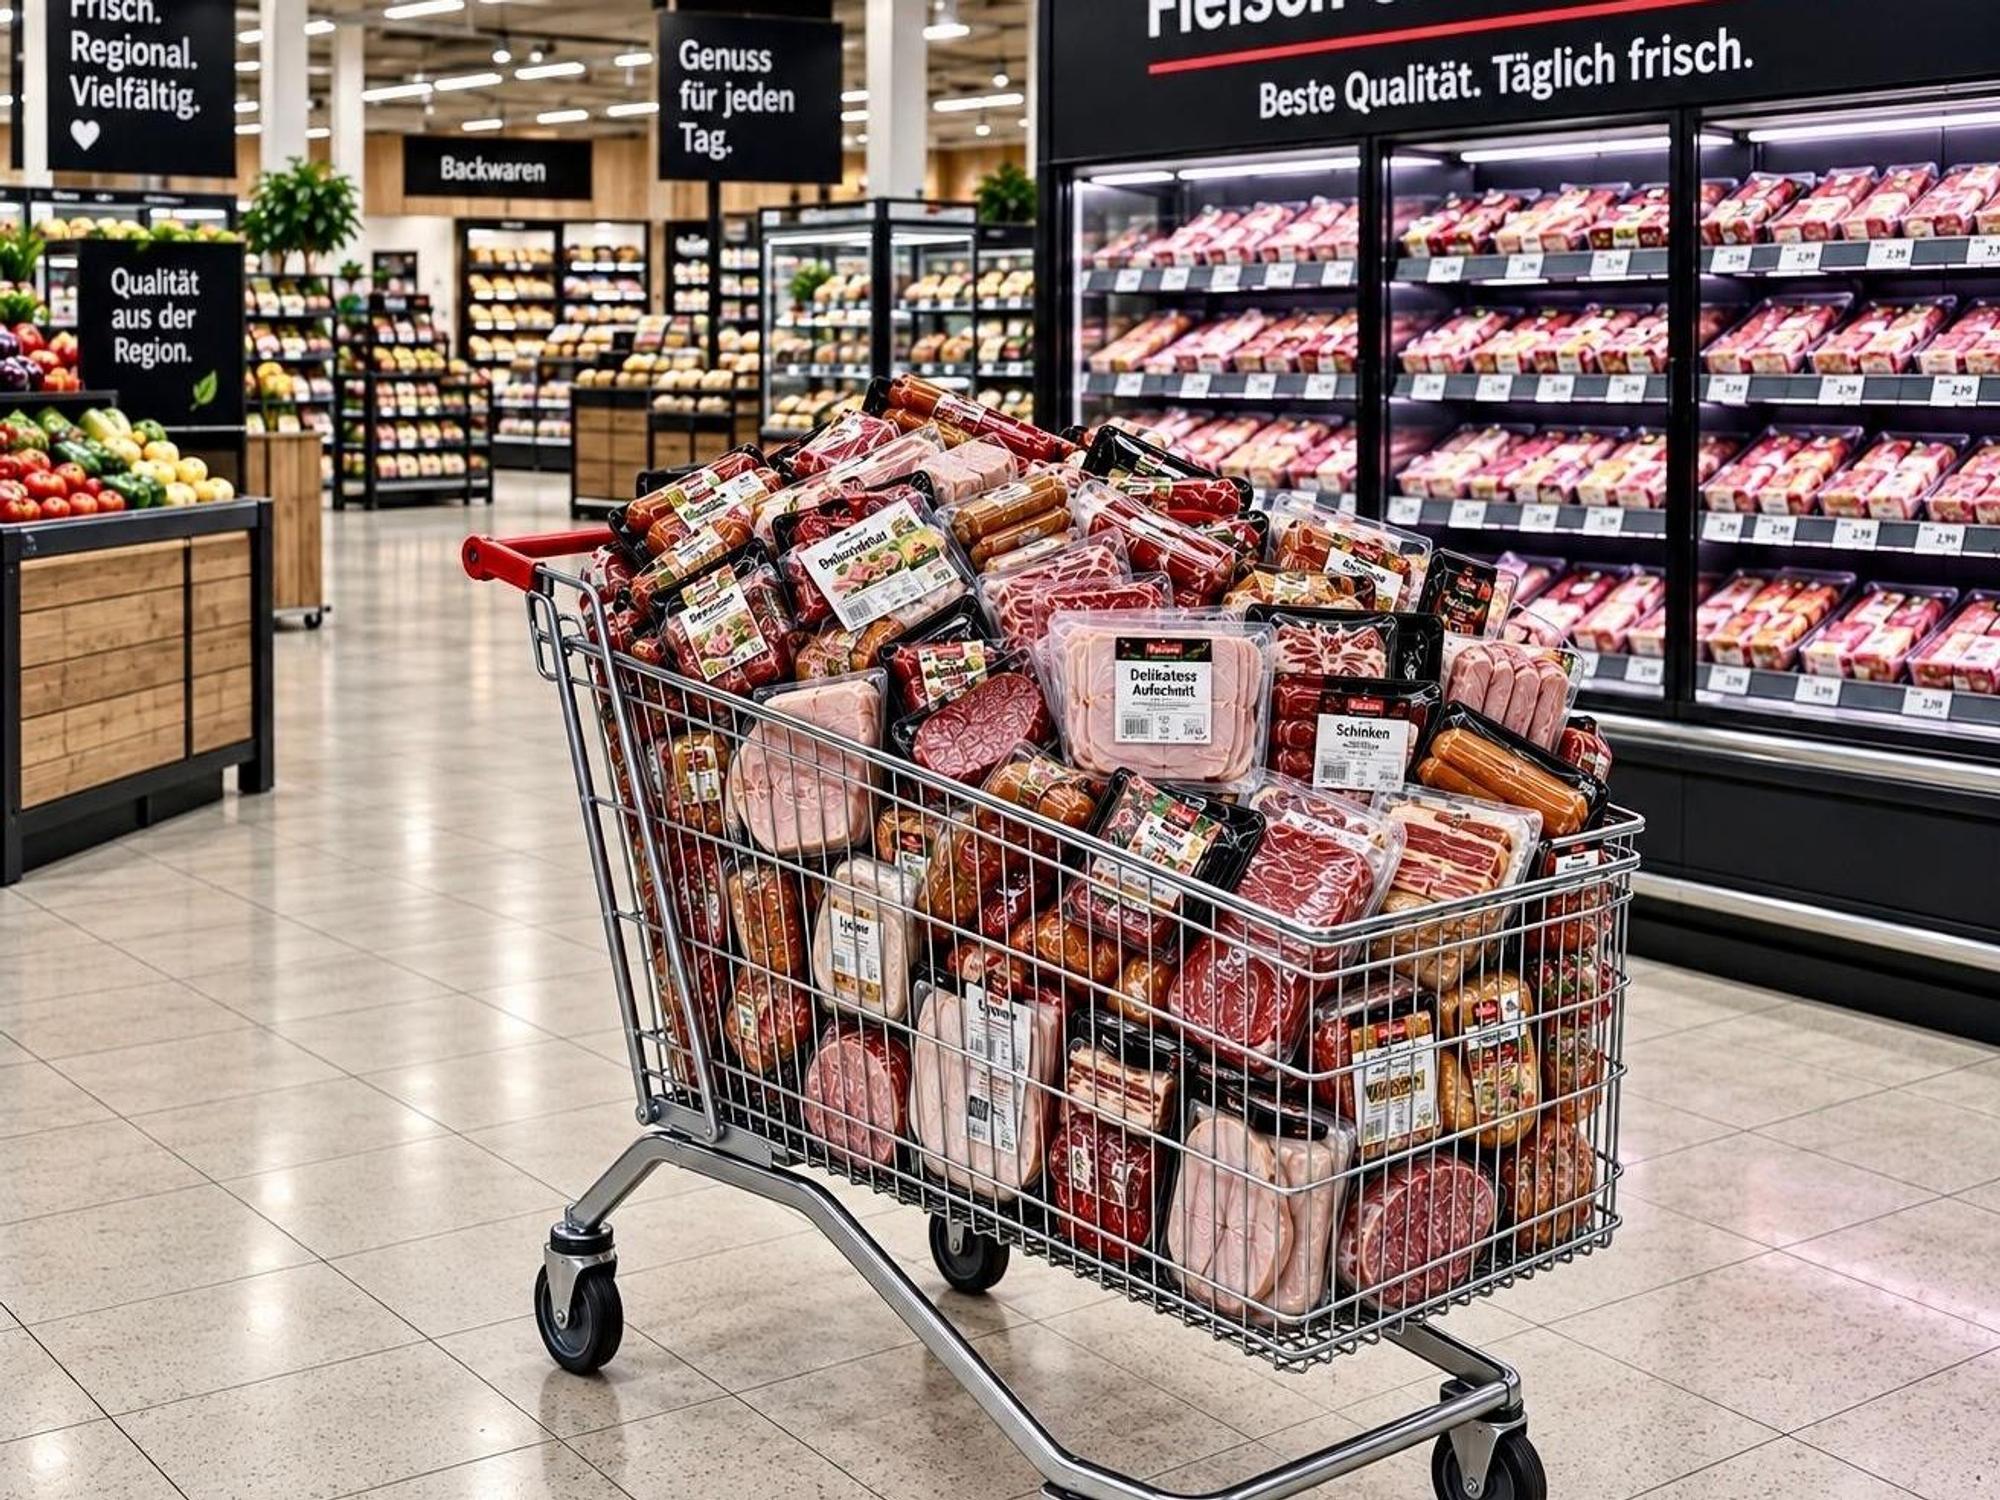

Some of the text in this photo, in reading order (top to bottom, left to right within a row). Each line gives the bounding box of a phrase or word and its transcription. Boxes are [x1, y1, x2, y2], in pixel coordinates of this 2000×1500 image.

[71, 0, 162, 24] Frisch.
[1147, 0, 1344, 38] Fles
[71, 30, 198, 72] Regional.
[679, 39, 773, 73] Genuss
[1260, 27, 1754, 119] Beste Qualität. Täglich frisch.
[69, 74, 201, 120] Vielfältig.
[679, 79, 795, 119] für jeden
[678, 122, 733, 160] Tag.
[441, 155, 547, 182] Backwaren
[111, 266, 201, 300] Qualität
[111, 301, 197, 329] aus der
[114, 336, 193, 370] Region.
[1336, 723, 1391, 740] Schinken
